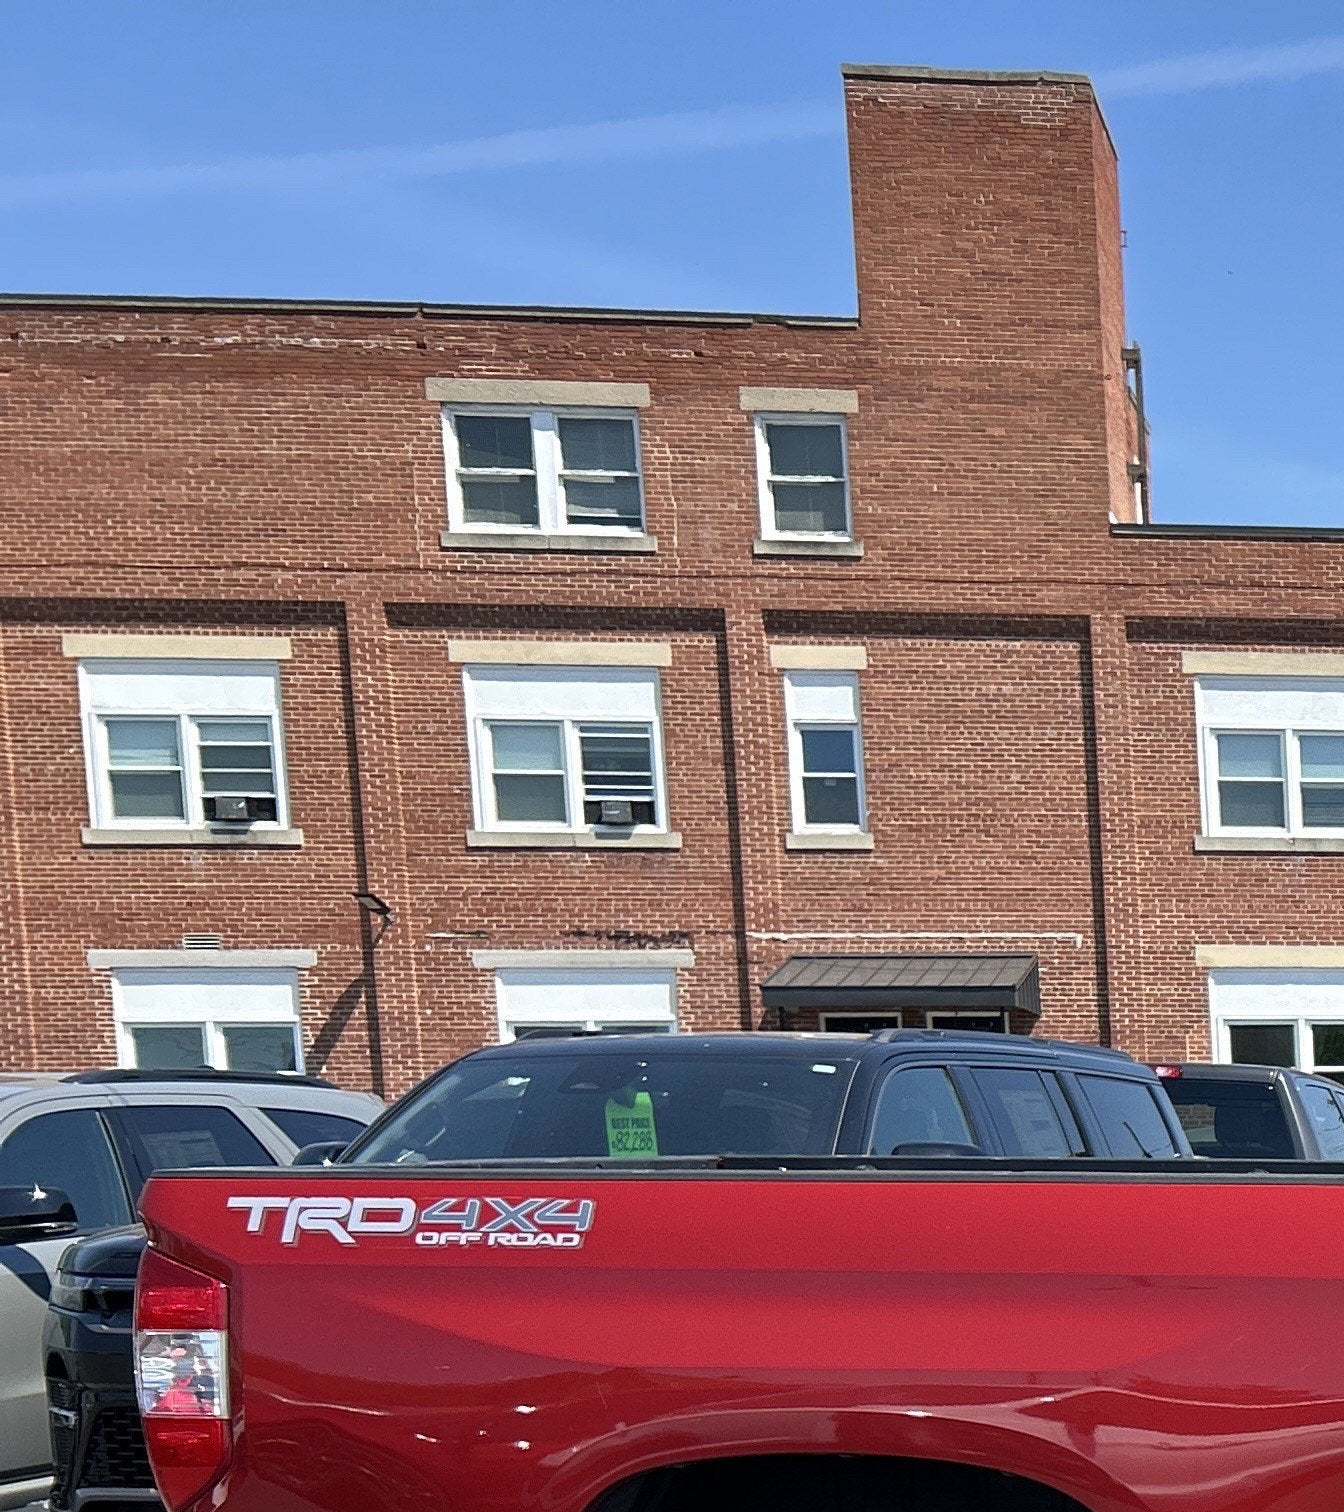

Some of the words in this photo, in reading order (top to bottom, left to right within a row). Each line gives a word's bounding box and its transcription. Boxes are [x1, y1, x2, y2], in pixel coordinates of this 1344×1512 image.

[227, 1196, 419, 1244] TRD
[415, 1231, 483, 1247] OFF
[487, 1231, 584, 1248] ROAD
